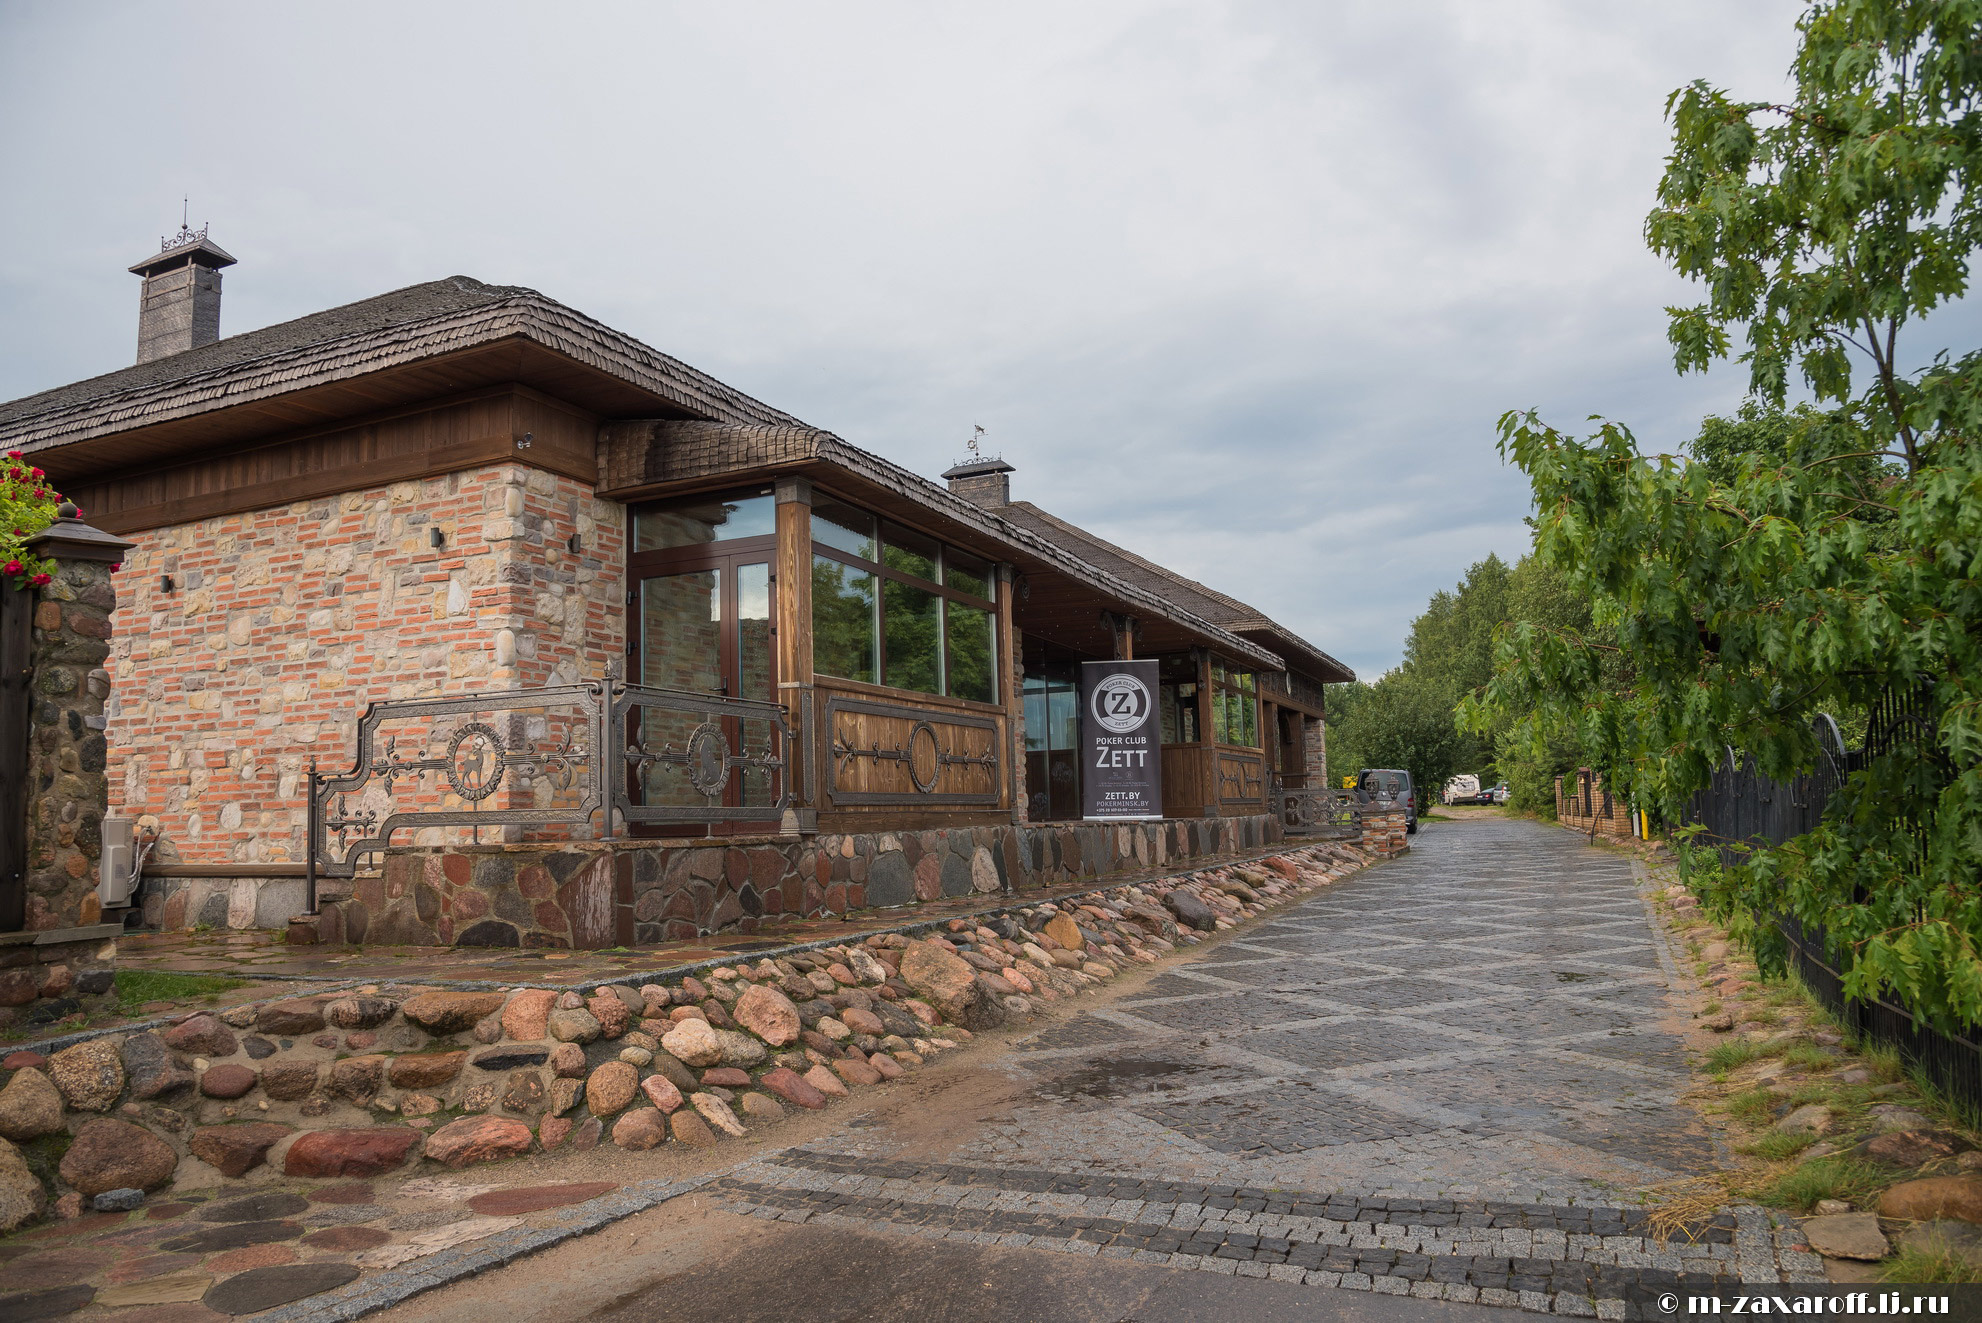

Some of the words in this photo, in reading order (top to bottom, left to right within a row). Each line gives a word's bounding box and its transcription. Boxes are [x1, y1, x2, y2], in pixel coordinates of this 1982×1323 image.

[1106, 681, 1122, 689] POKER
[1123, 681, 1136, 689] CLUB
[1112, 693, 1131, 714] Z
[1096, 737, 1123, 745] POKER
[1125, 736, 1147, 744] CLUB
[1105, 792, 1140, 800] ZETT.BY
